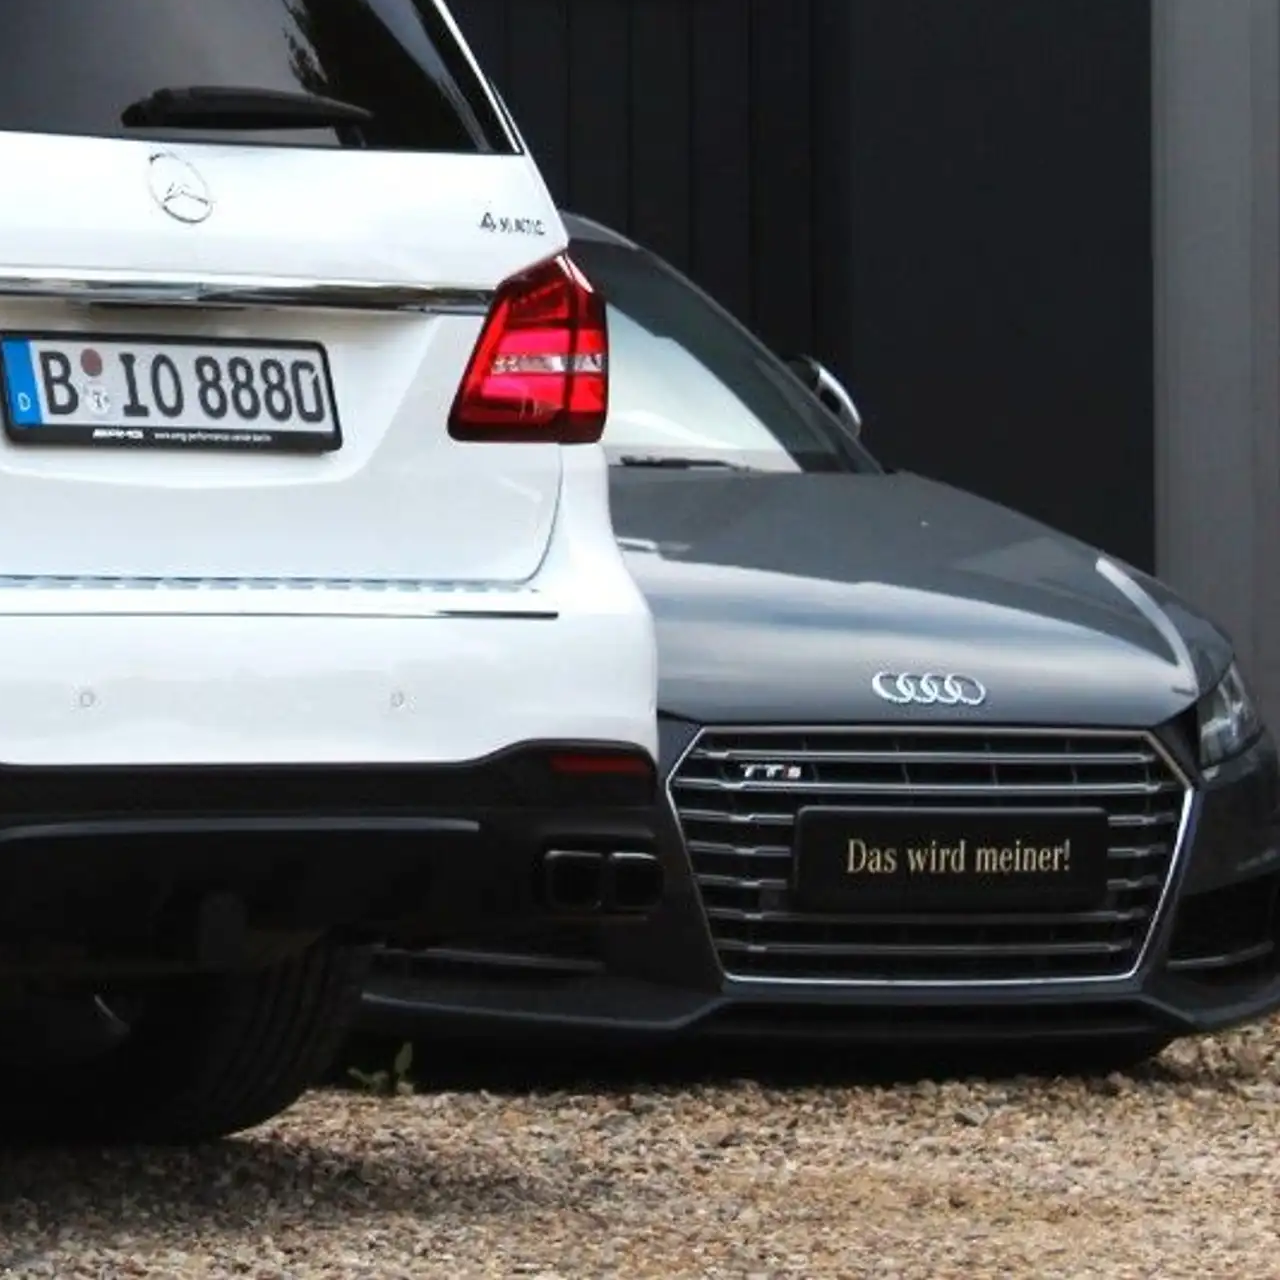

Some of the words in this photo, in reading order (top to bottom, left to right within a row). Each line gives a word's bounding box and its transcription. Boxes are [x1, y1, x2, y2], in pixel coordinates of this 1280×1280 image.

[39, 350, 79, 415] B
[194, 355, 326, 424] 8880
[847, 839, 898, 873] Das
[906, 838, 966, 873] wird
[975, 838, 1072, 875] meiner!
